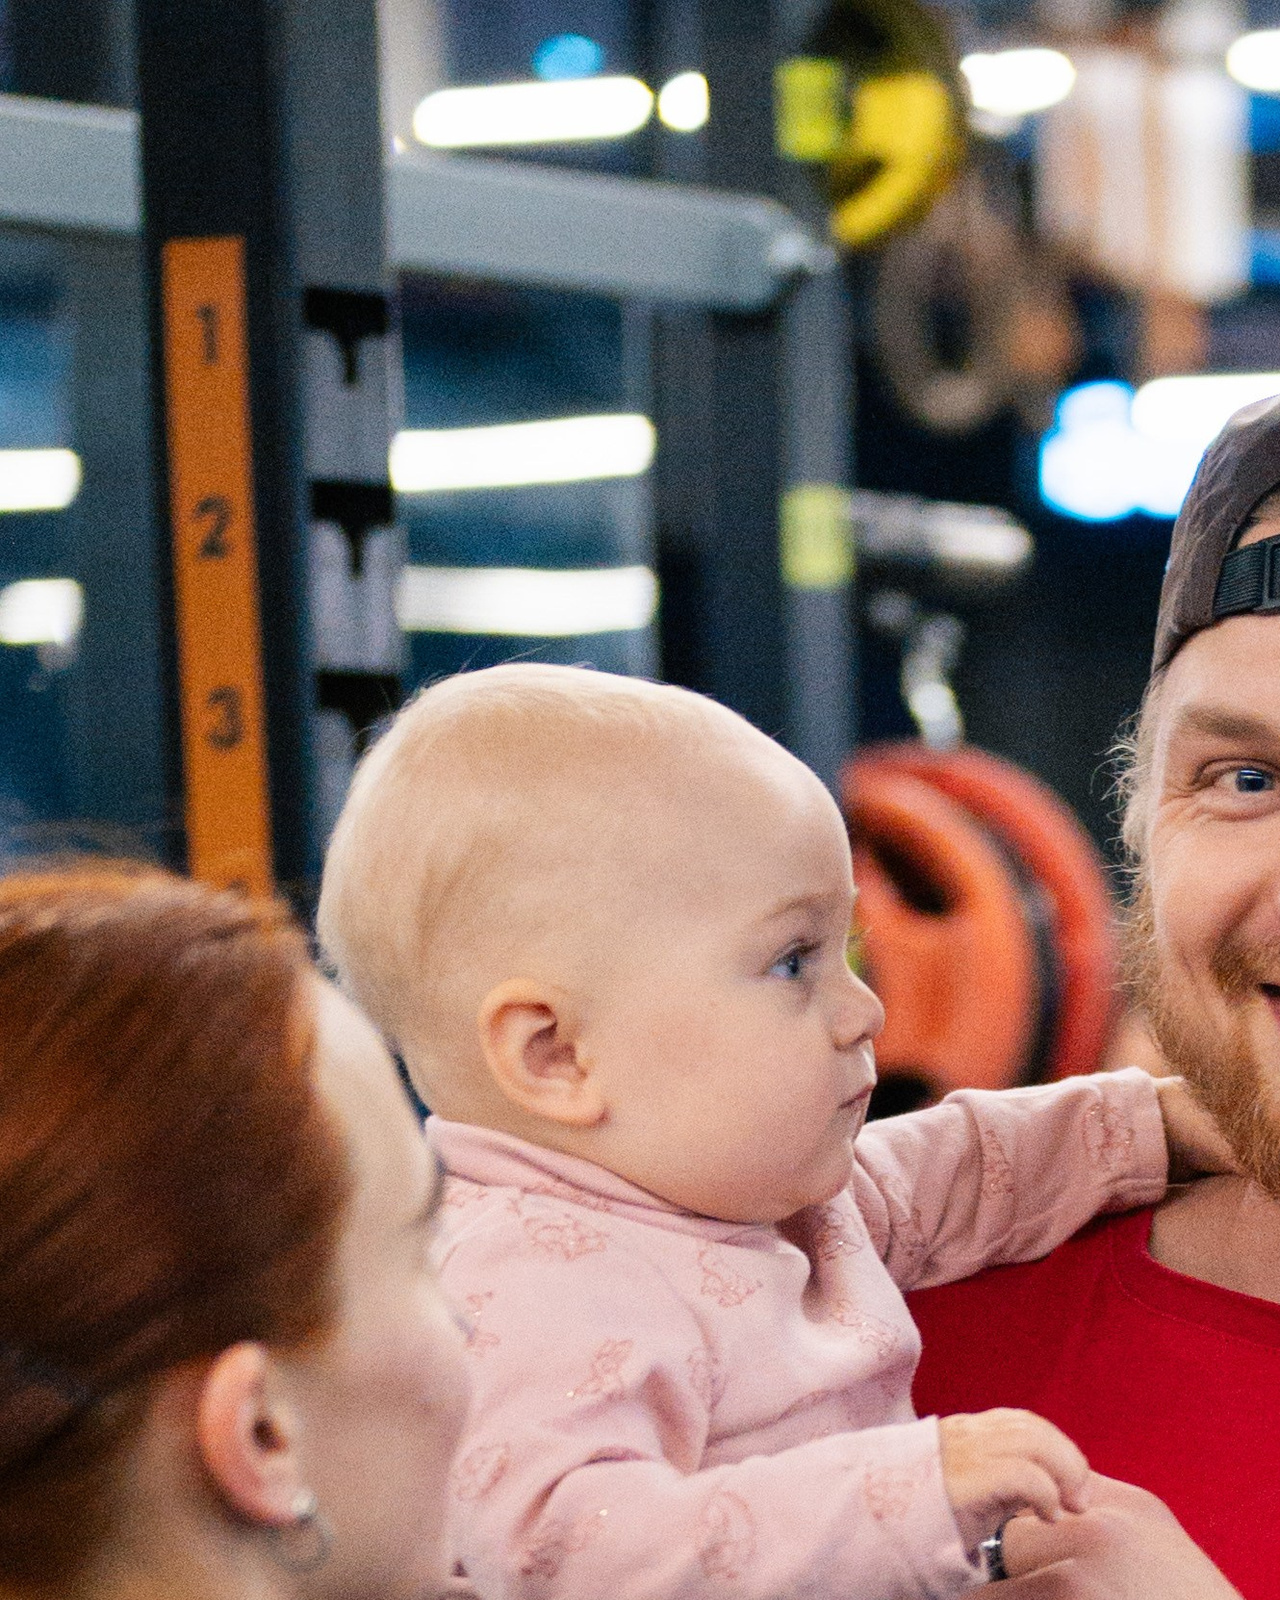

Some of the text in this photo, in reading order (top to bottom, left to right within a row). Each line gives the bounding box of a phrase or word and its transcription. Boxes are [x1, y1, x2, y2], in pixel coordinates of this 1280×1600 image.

[197, 303, 219, 367] 1
[193, 493, 233, 560] 2
[207, 685, 244, 752] 3
